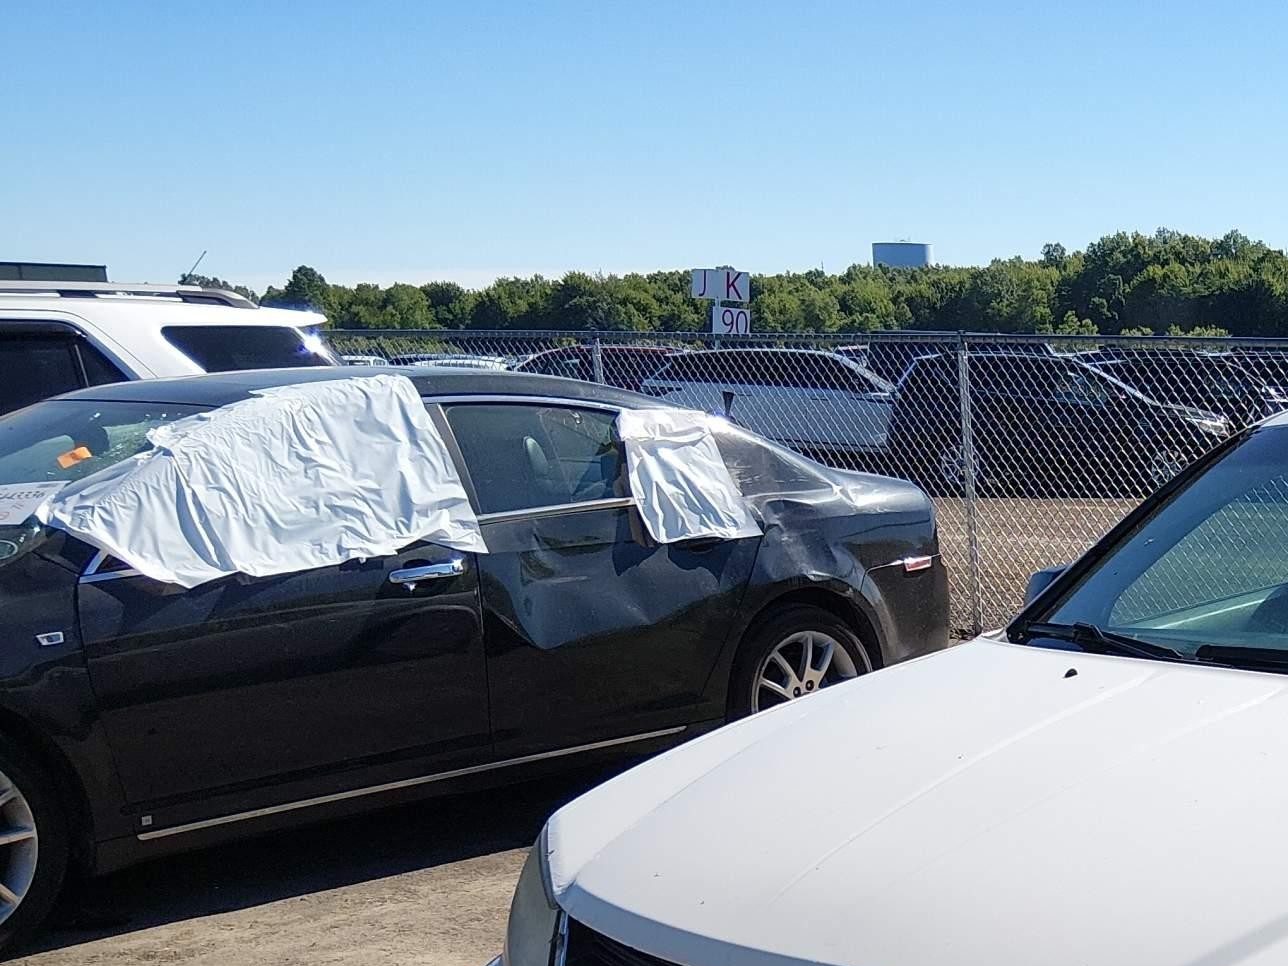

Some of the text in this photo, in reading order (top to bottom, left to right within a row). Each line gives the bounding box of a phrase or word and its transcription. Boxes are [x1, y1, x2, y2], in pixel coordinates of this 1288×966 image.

[699, 270, 706, 296] J
[727, 272, 742, 300] K
[722, 309, 747, 333] 90
